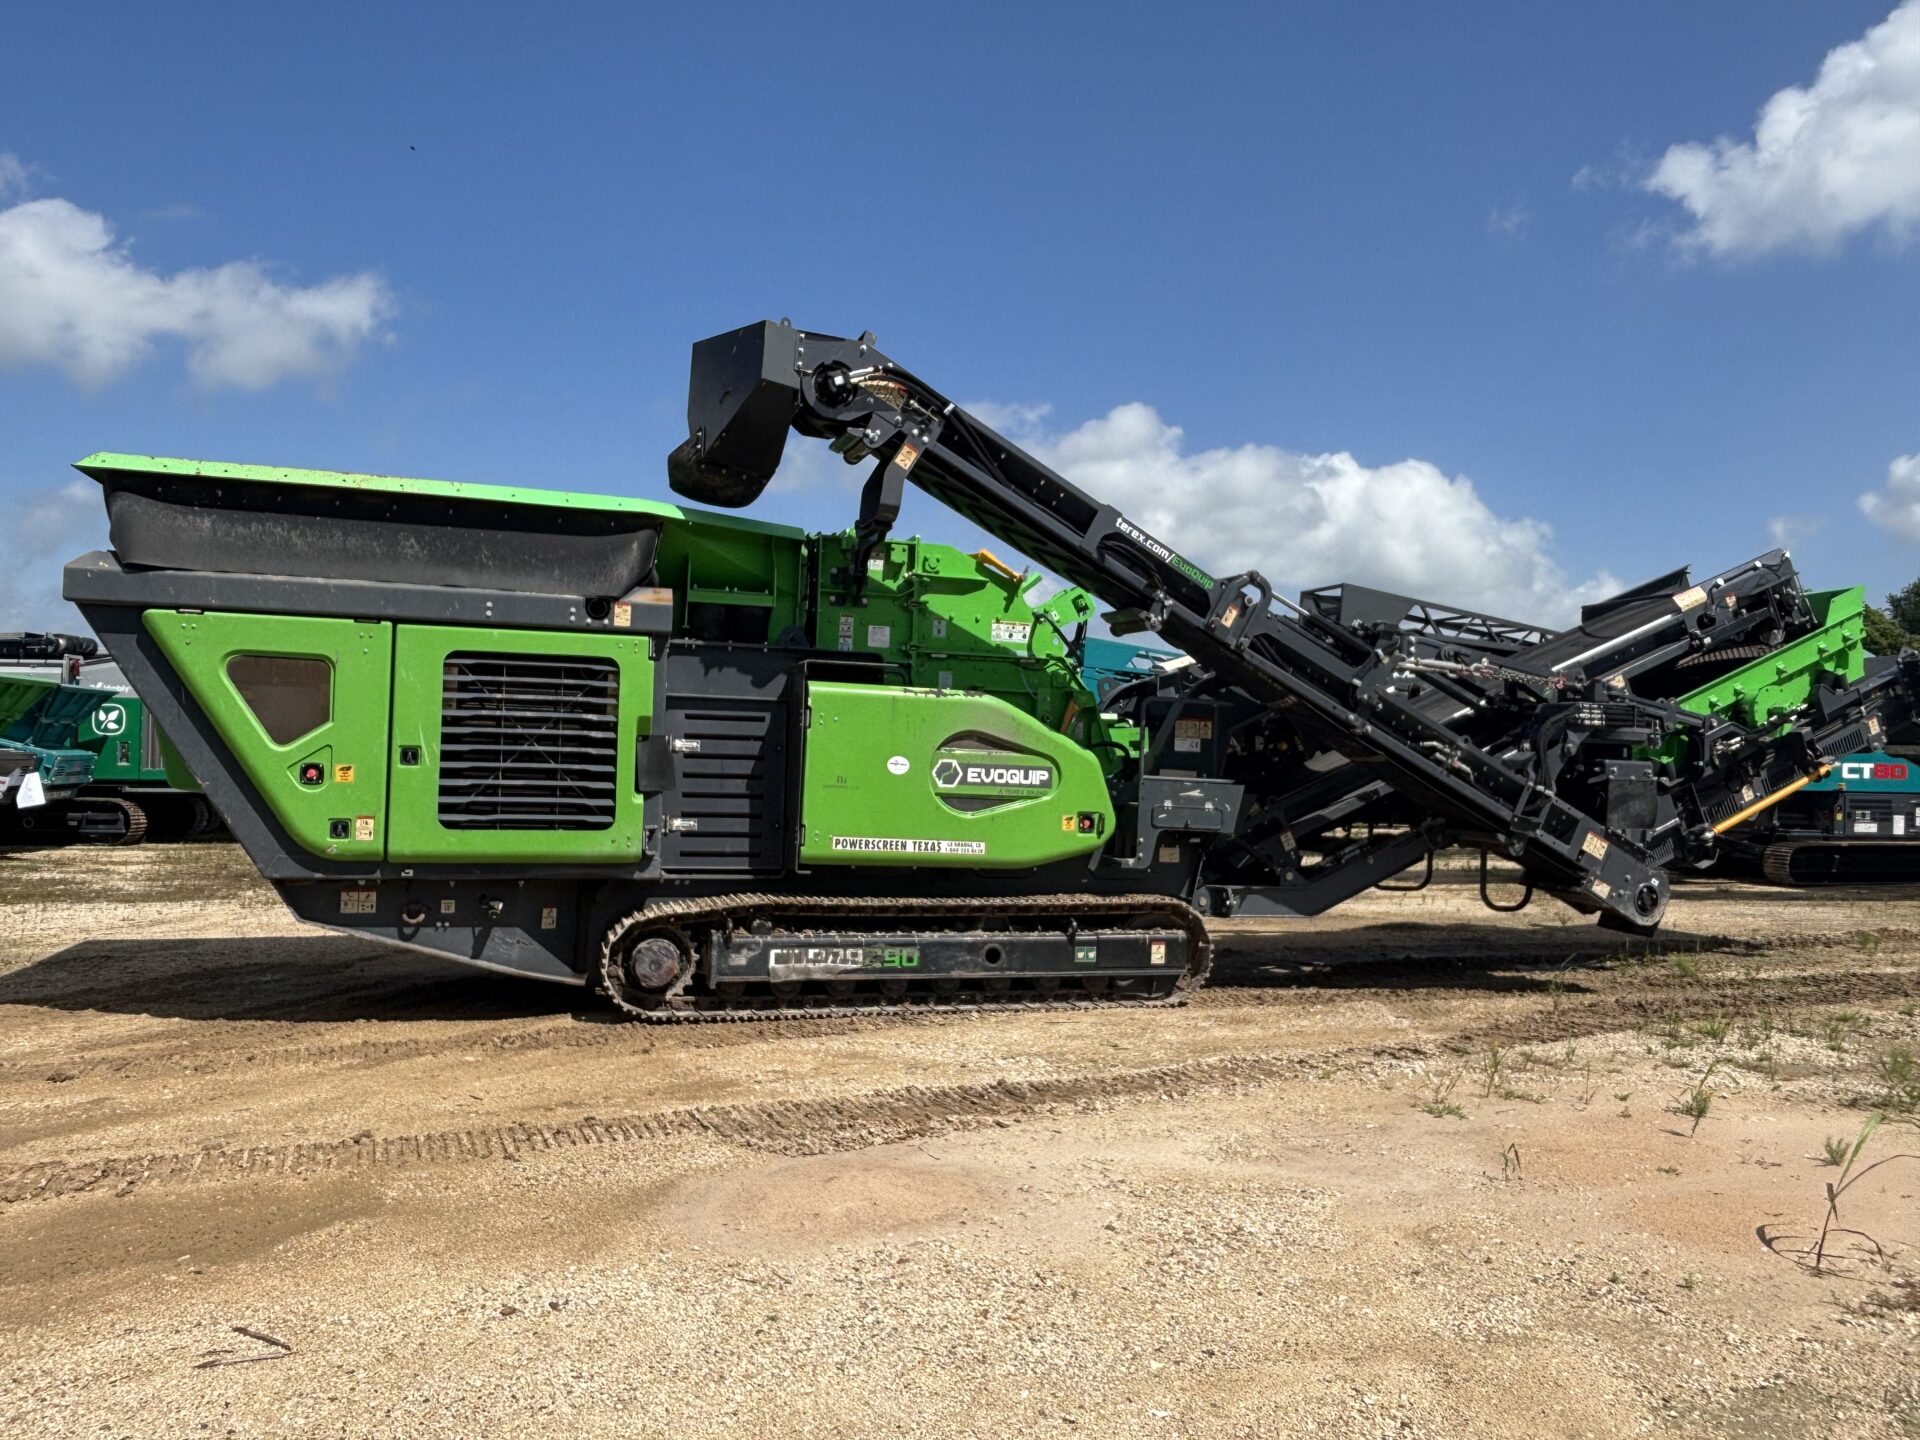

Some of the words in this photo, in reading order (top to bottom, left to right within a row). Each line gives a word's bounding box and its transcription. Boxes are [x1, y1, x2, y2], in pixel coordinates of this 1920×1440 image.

[966, 767, 1049, 786] EVOQUIP
[834, 838, 908, 851] POWERSCREEN
[912, 840, 942, 852] TEXAS
